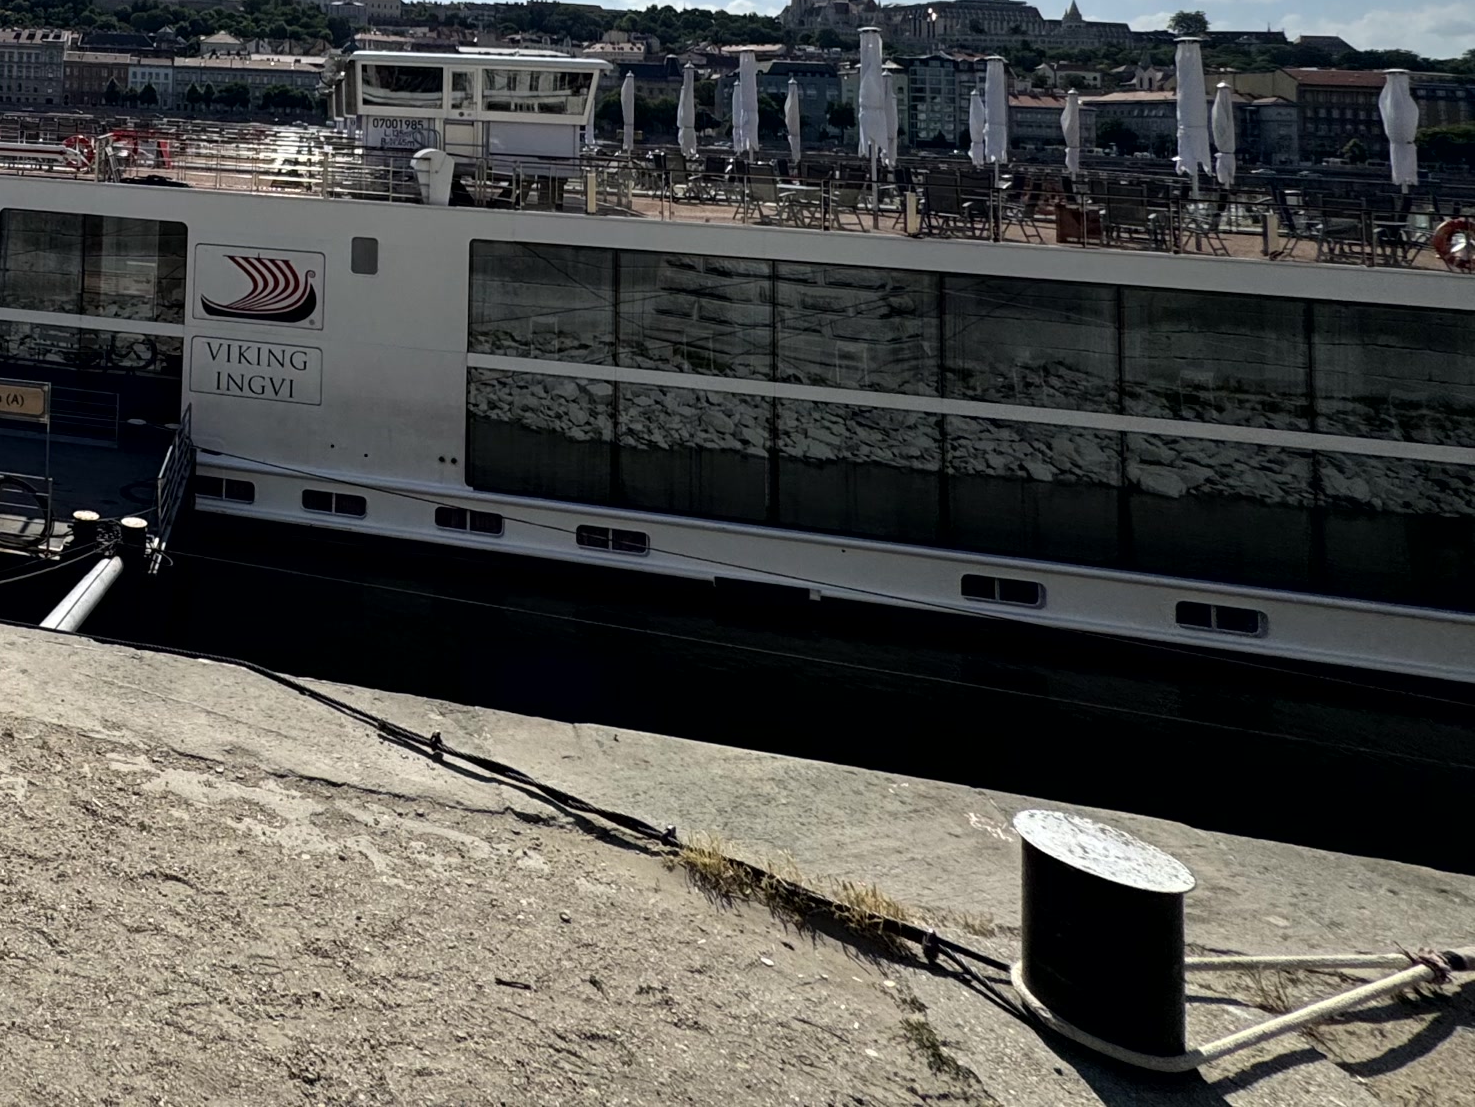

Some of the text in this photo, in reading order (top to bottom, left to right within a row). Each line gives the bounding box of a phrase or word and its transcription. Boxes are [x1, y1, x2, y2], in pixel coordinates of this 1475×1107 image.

[372, 118, 424, 130] 07001985
[205, 341, 308, 371] VIKING
[215, 371, 295, 399] INGVI
[6, 392, 25, 407] (A)
